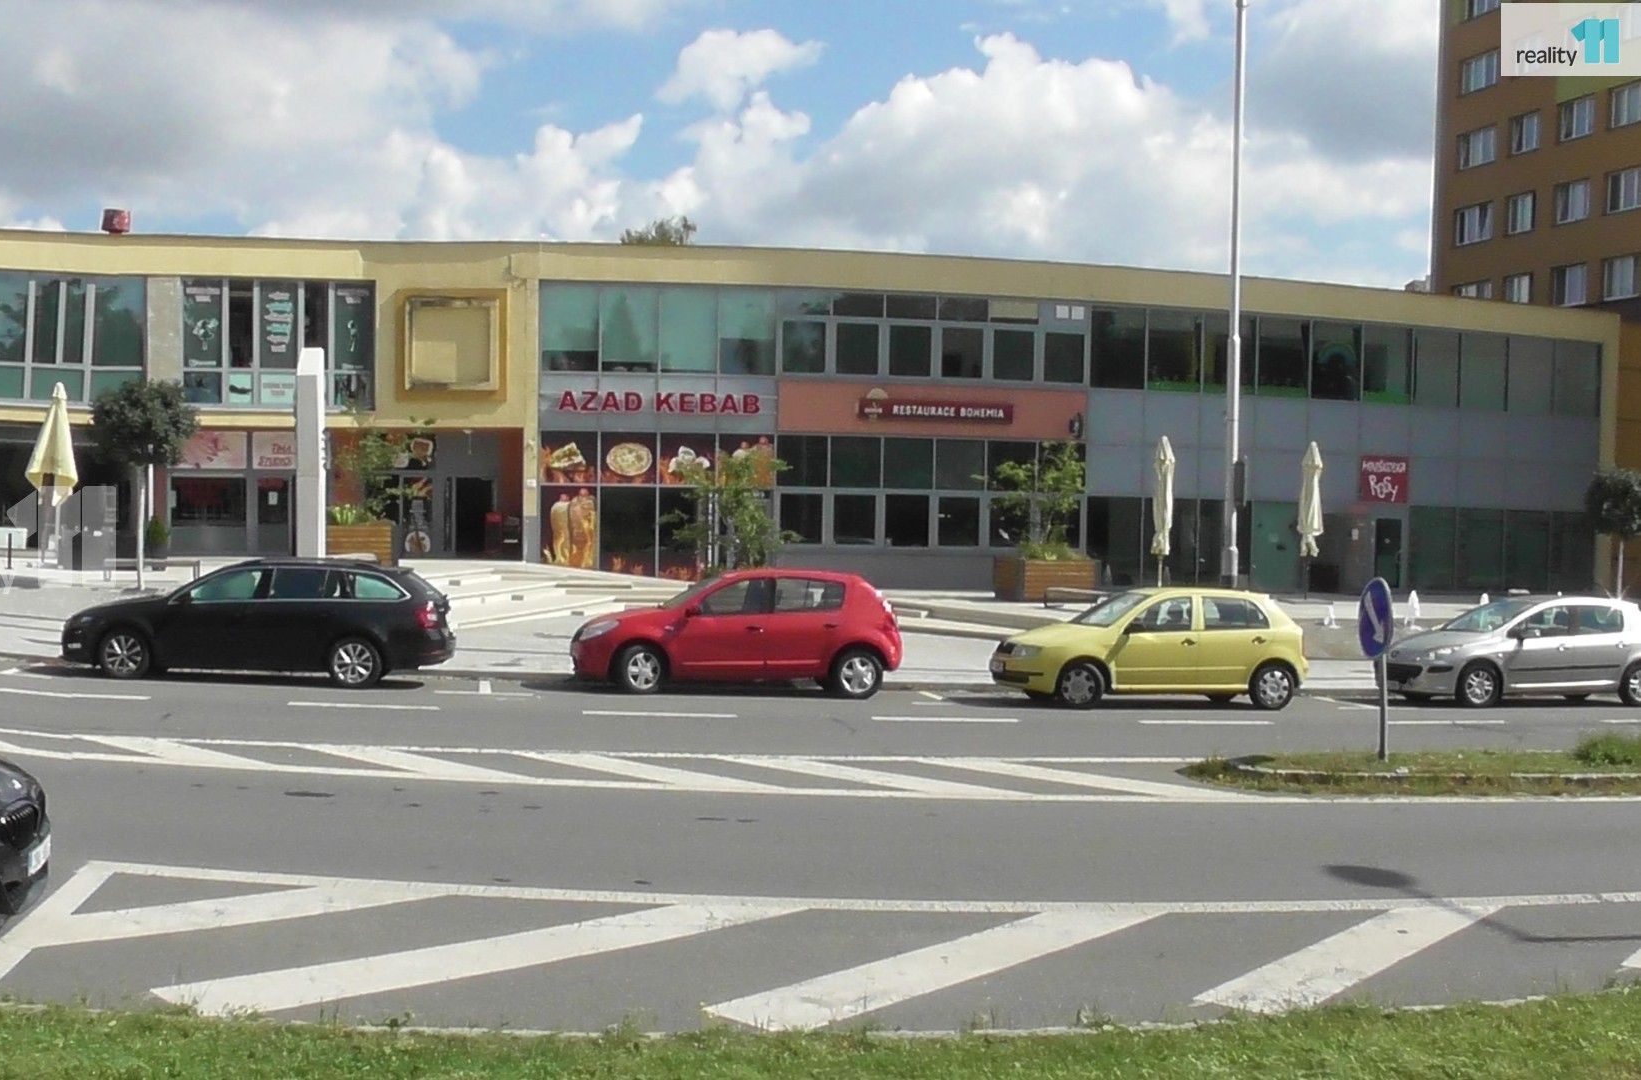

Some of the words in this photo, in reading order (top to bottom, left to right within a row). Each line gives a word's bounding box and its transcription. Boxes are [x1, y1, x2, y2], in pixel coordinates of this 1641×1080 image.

[558, 390, 644, 412] AZAD
[654, 392, 761, 415] KEBAB
[891, 404, 956, 418] RESTAURACE
[959, 406, 1005, 419] BOHEMIA
